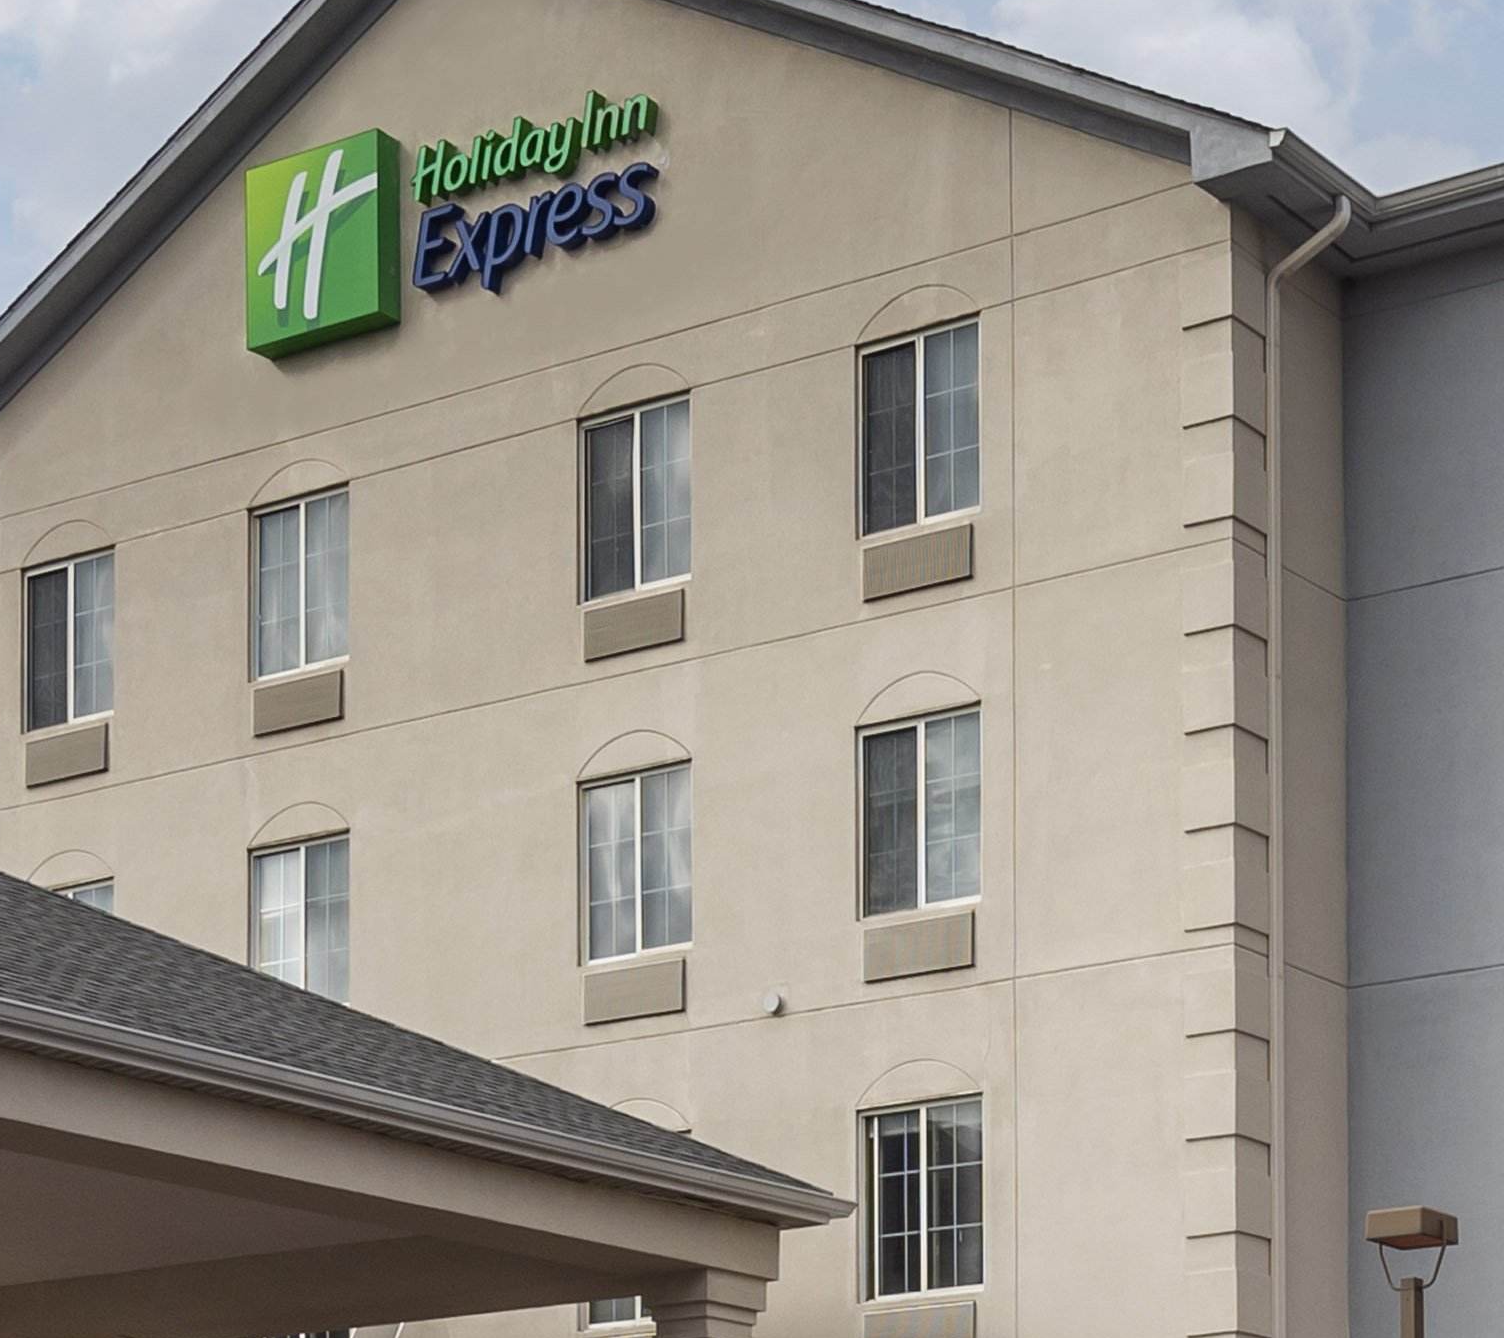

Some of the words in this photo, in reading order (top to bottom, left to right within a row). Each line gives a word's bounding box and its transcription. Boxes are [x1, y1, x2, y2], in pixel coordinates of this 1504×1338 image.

[411, 116, 583, 207] Holiday
[581, 89, 659, 154] Inn
[412, 162, 660, 295] Express
